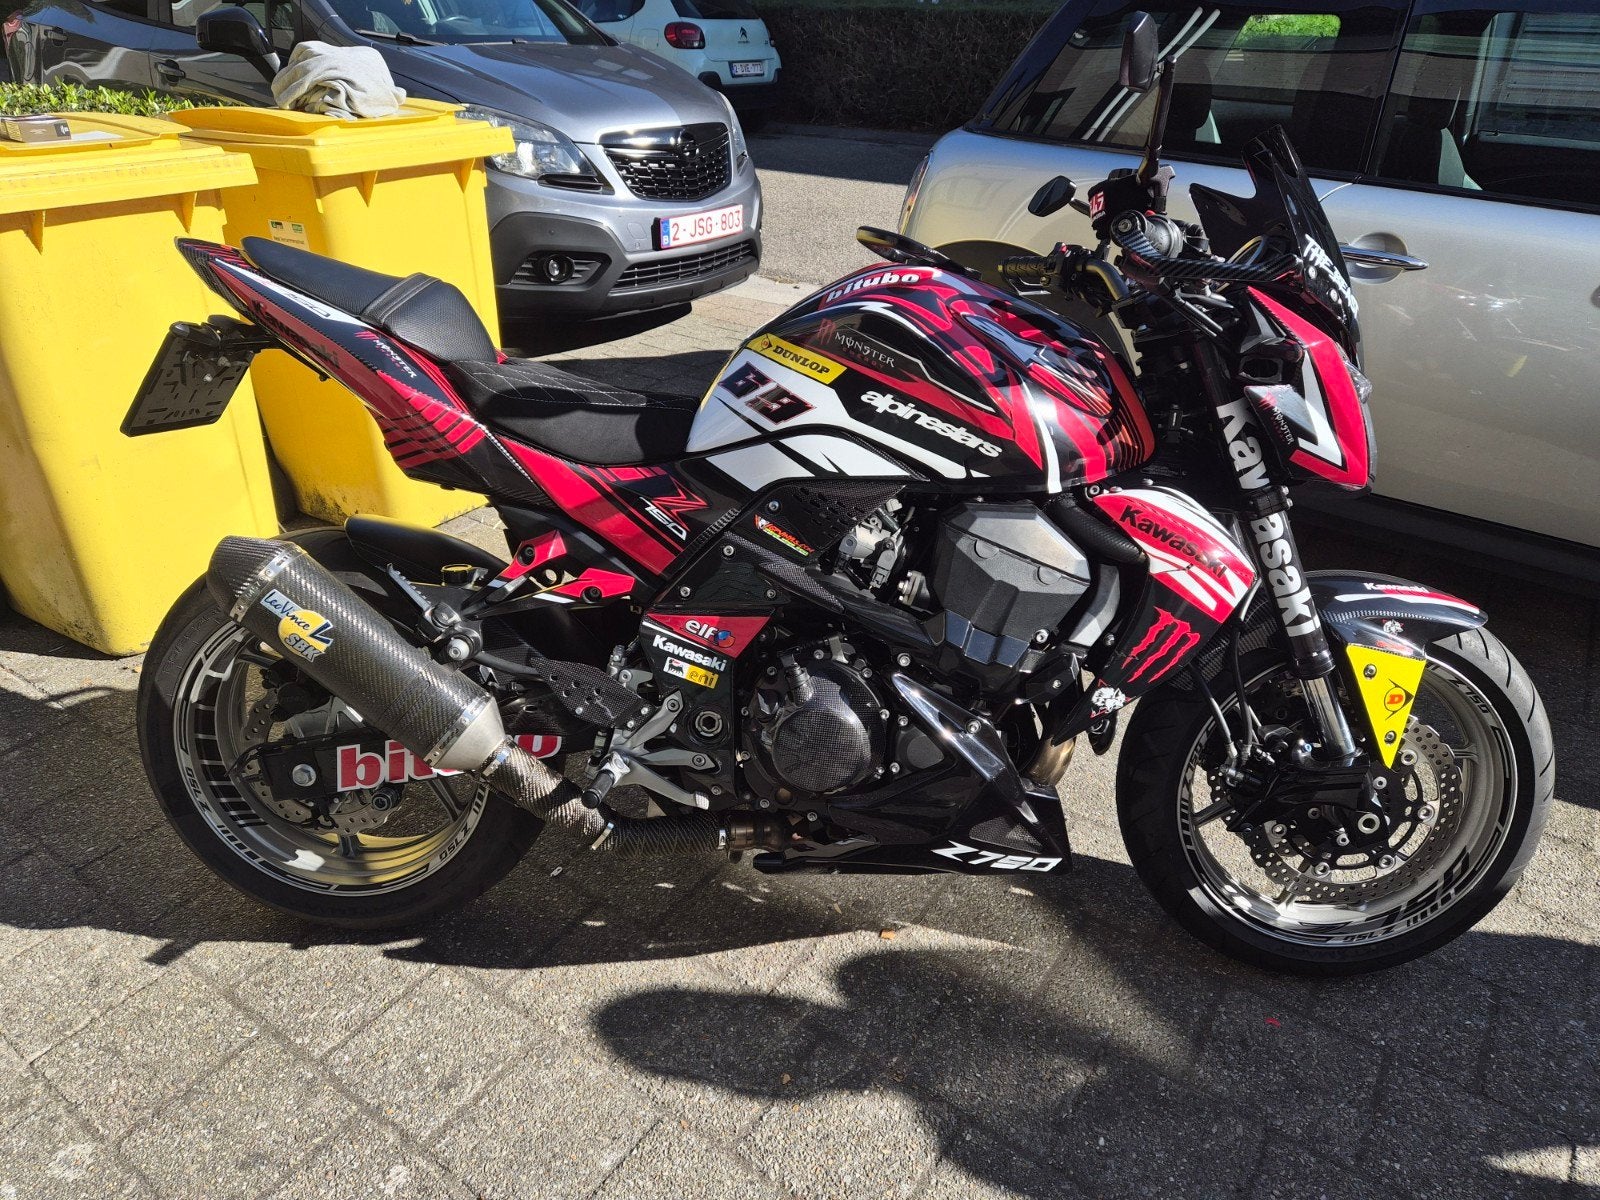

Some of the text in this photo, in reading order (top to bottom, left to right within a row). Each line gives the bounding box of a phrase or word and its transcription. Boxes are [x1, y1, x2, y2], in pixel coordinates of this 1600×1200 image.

[1303, 233, 1336, 275] THE
[826, 272, 919, 303] bitubo
[773, 344, 831, 375] DUNLOP
[835, 331, 895, 368] MONSTER
[860, 390, 1003, 458] alpinestars
[638, 496, 688, 541] 750
[1120, 504, 1228, 578] Kawasaki
[264, 590, 311, 632] LeoVince
[684, 619, 719, 640] elf
[284, 632, 321, 662] SBK
[652, 634, 727, 672] Kawasaki
[689, 669, 715, 687] eni
[930, 839, 1063, 873] Z750
